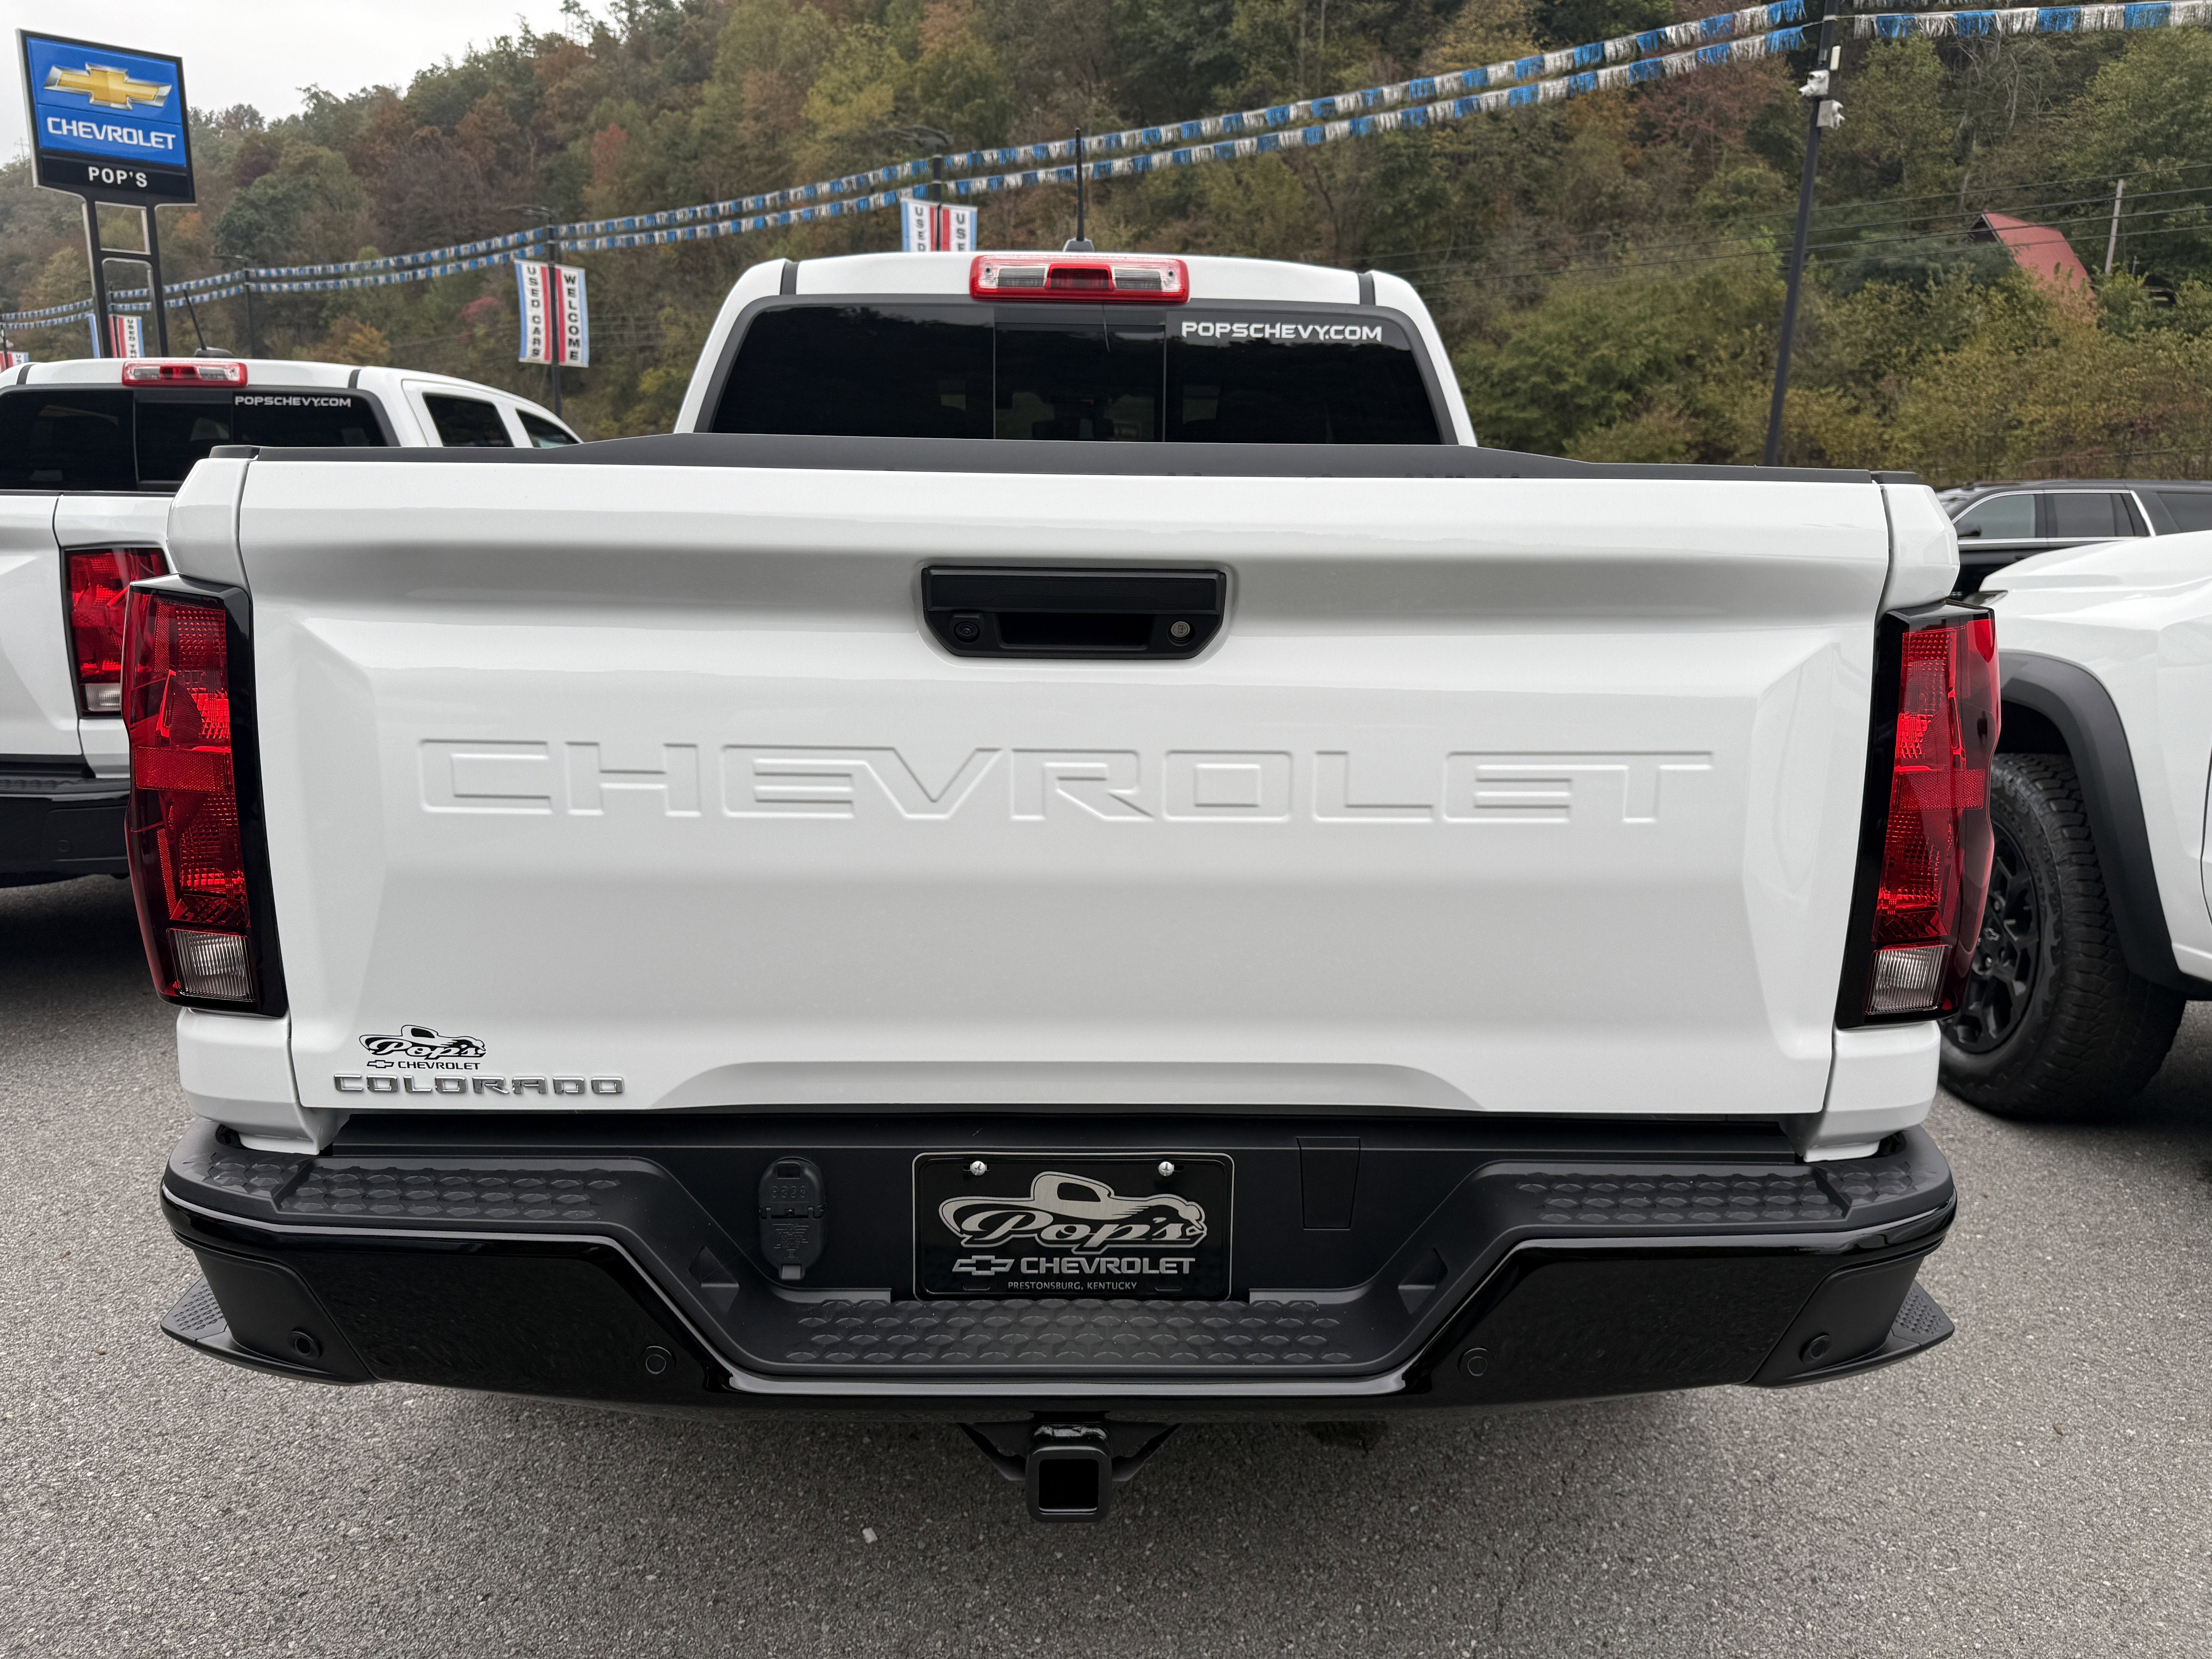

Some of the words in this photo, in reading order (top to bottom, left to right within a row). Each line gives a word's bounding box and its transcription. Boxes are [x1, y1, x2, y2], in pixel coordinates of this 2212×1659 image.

[47, 117, 176, 150] CHEVROLET
[88, 166, 147, 188] POP'S
[915, 206, 927, 251] USED
[956, 213, 966, 251] USE
[527, 266, 540, 308] USED
[564, 275, 580, 360] WELCOME
[532, 315, 541, 357] CARS
[1182, 321, 1382, 342] POPSCHEVY.COM
[235, 396, 351, 407] POPSCHEVY.COM
[419, 740, 1713, 824] CHEVROLET
[368, 1039, 483, 1060] Pop's
[398, 1061, 480, 1070] CHEVROLET
[334, 1074, 625, 1095] COLORADO
[961, 1210, 1192, 1248] Pop's
[1020, 1257, 1195, 1274] CHEVROLET
[1008, 1281, 1084, 1290] PRESTONSBURG,
[1087, 1281, 1137, 1290] KENTUCKY
